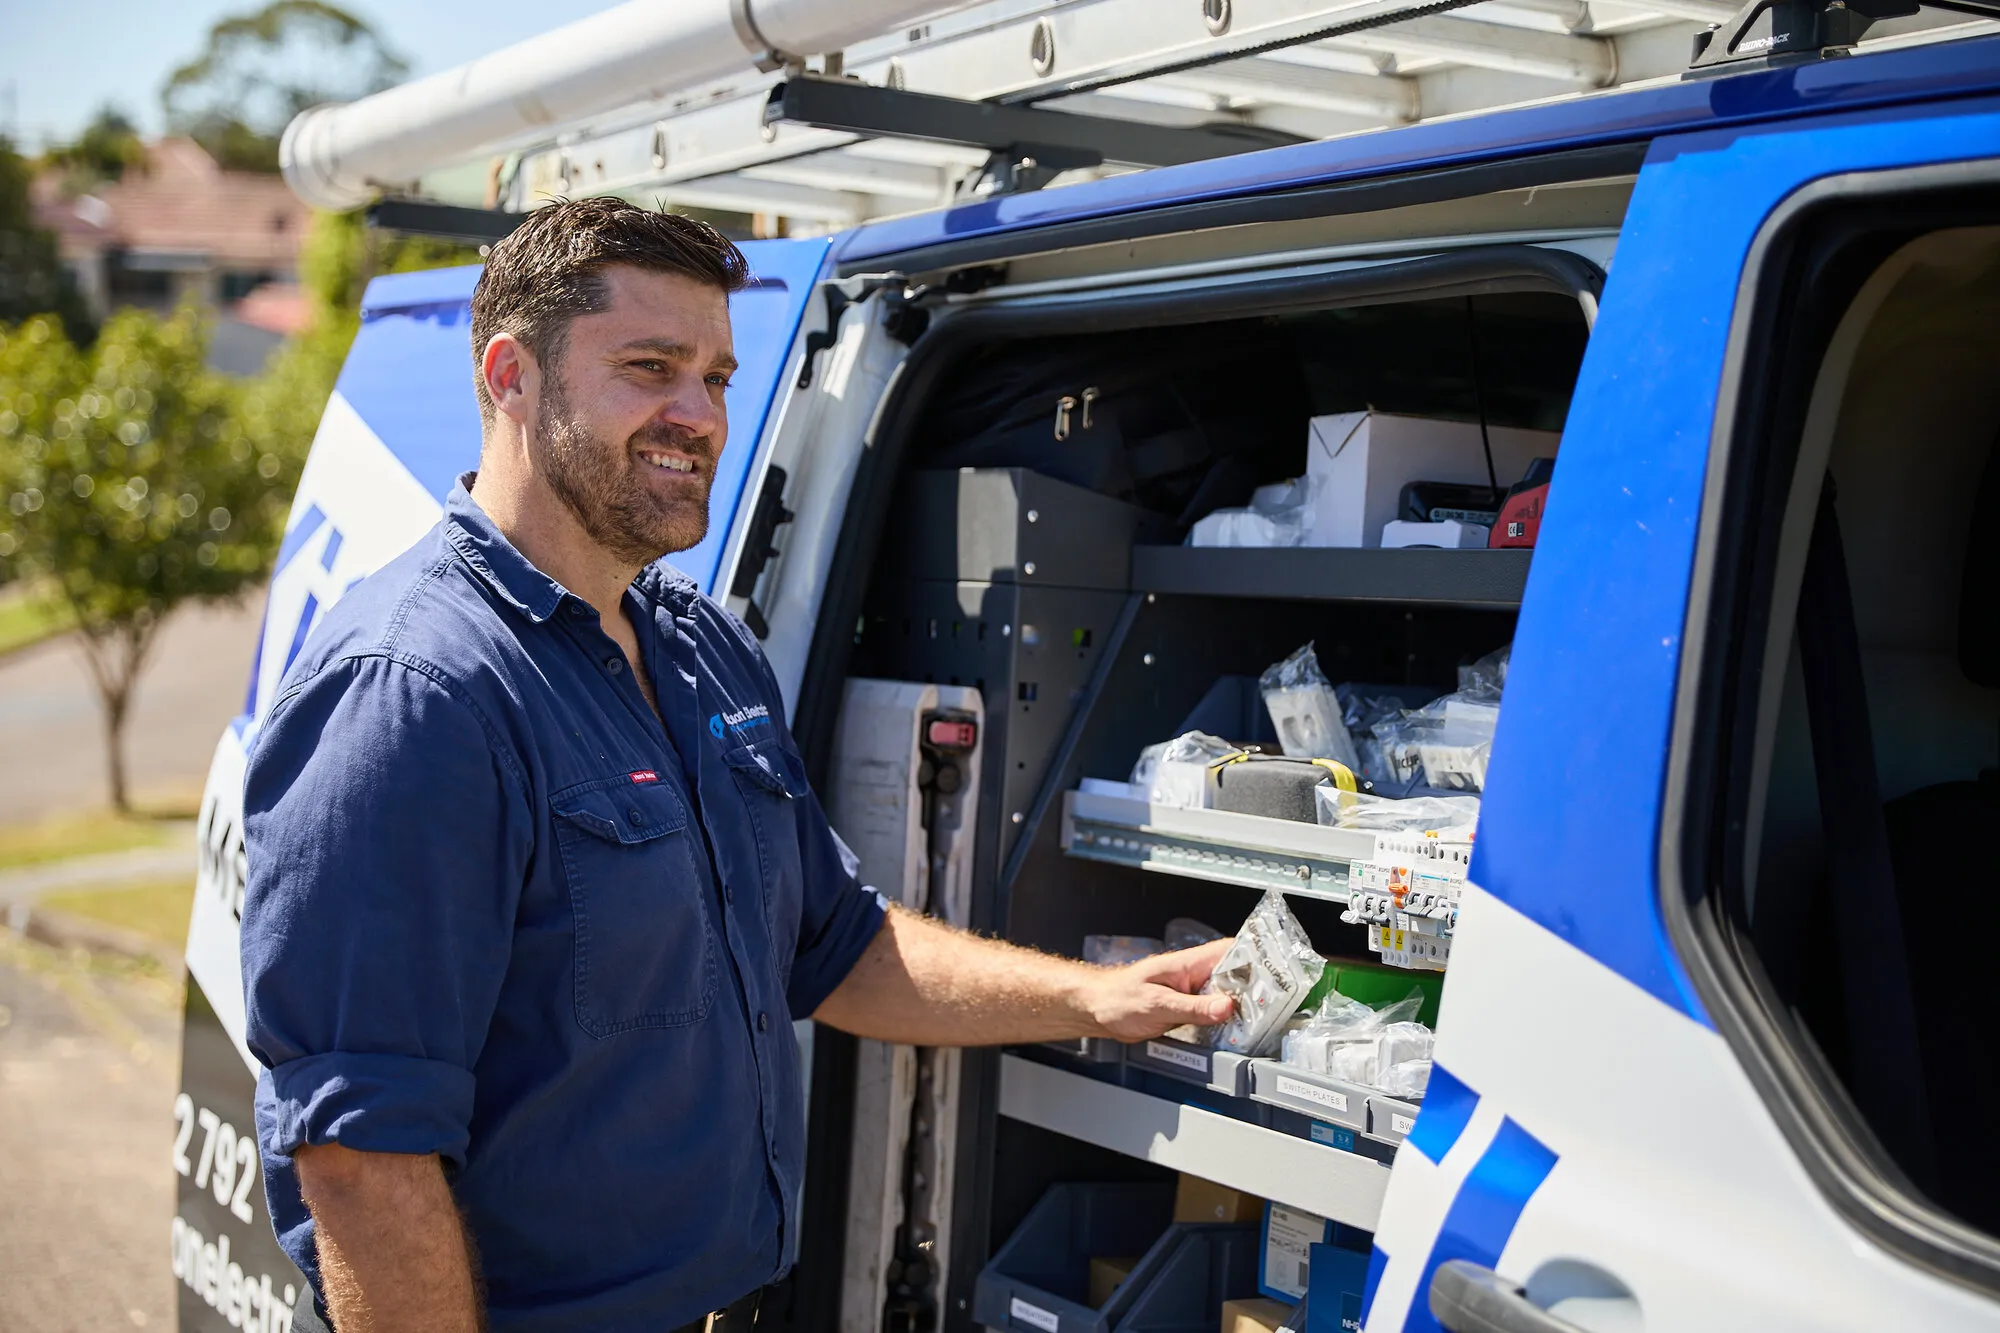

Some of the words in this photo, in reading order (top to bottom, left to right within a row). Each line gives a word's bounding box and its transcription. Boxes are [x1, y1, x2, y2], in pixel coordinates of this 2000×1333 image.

[1738, 33, 1790, 53] RHINO-RACK
[1263, 959, 1291, 992] CLIPSAL
[1283, 1082, 1311, 1096] SWITCH
[1312, 1089, 1341, 1105] PLATES
